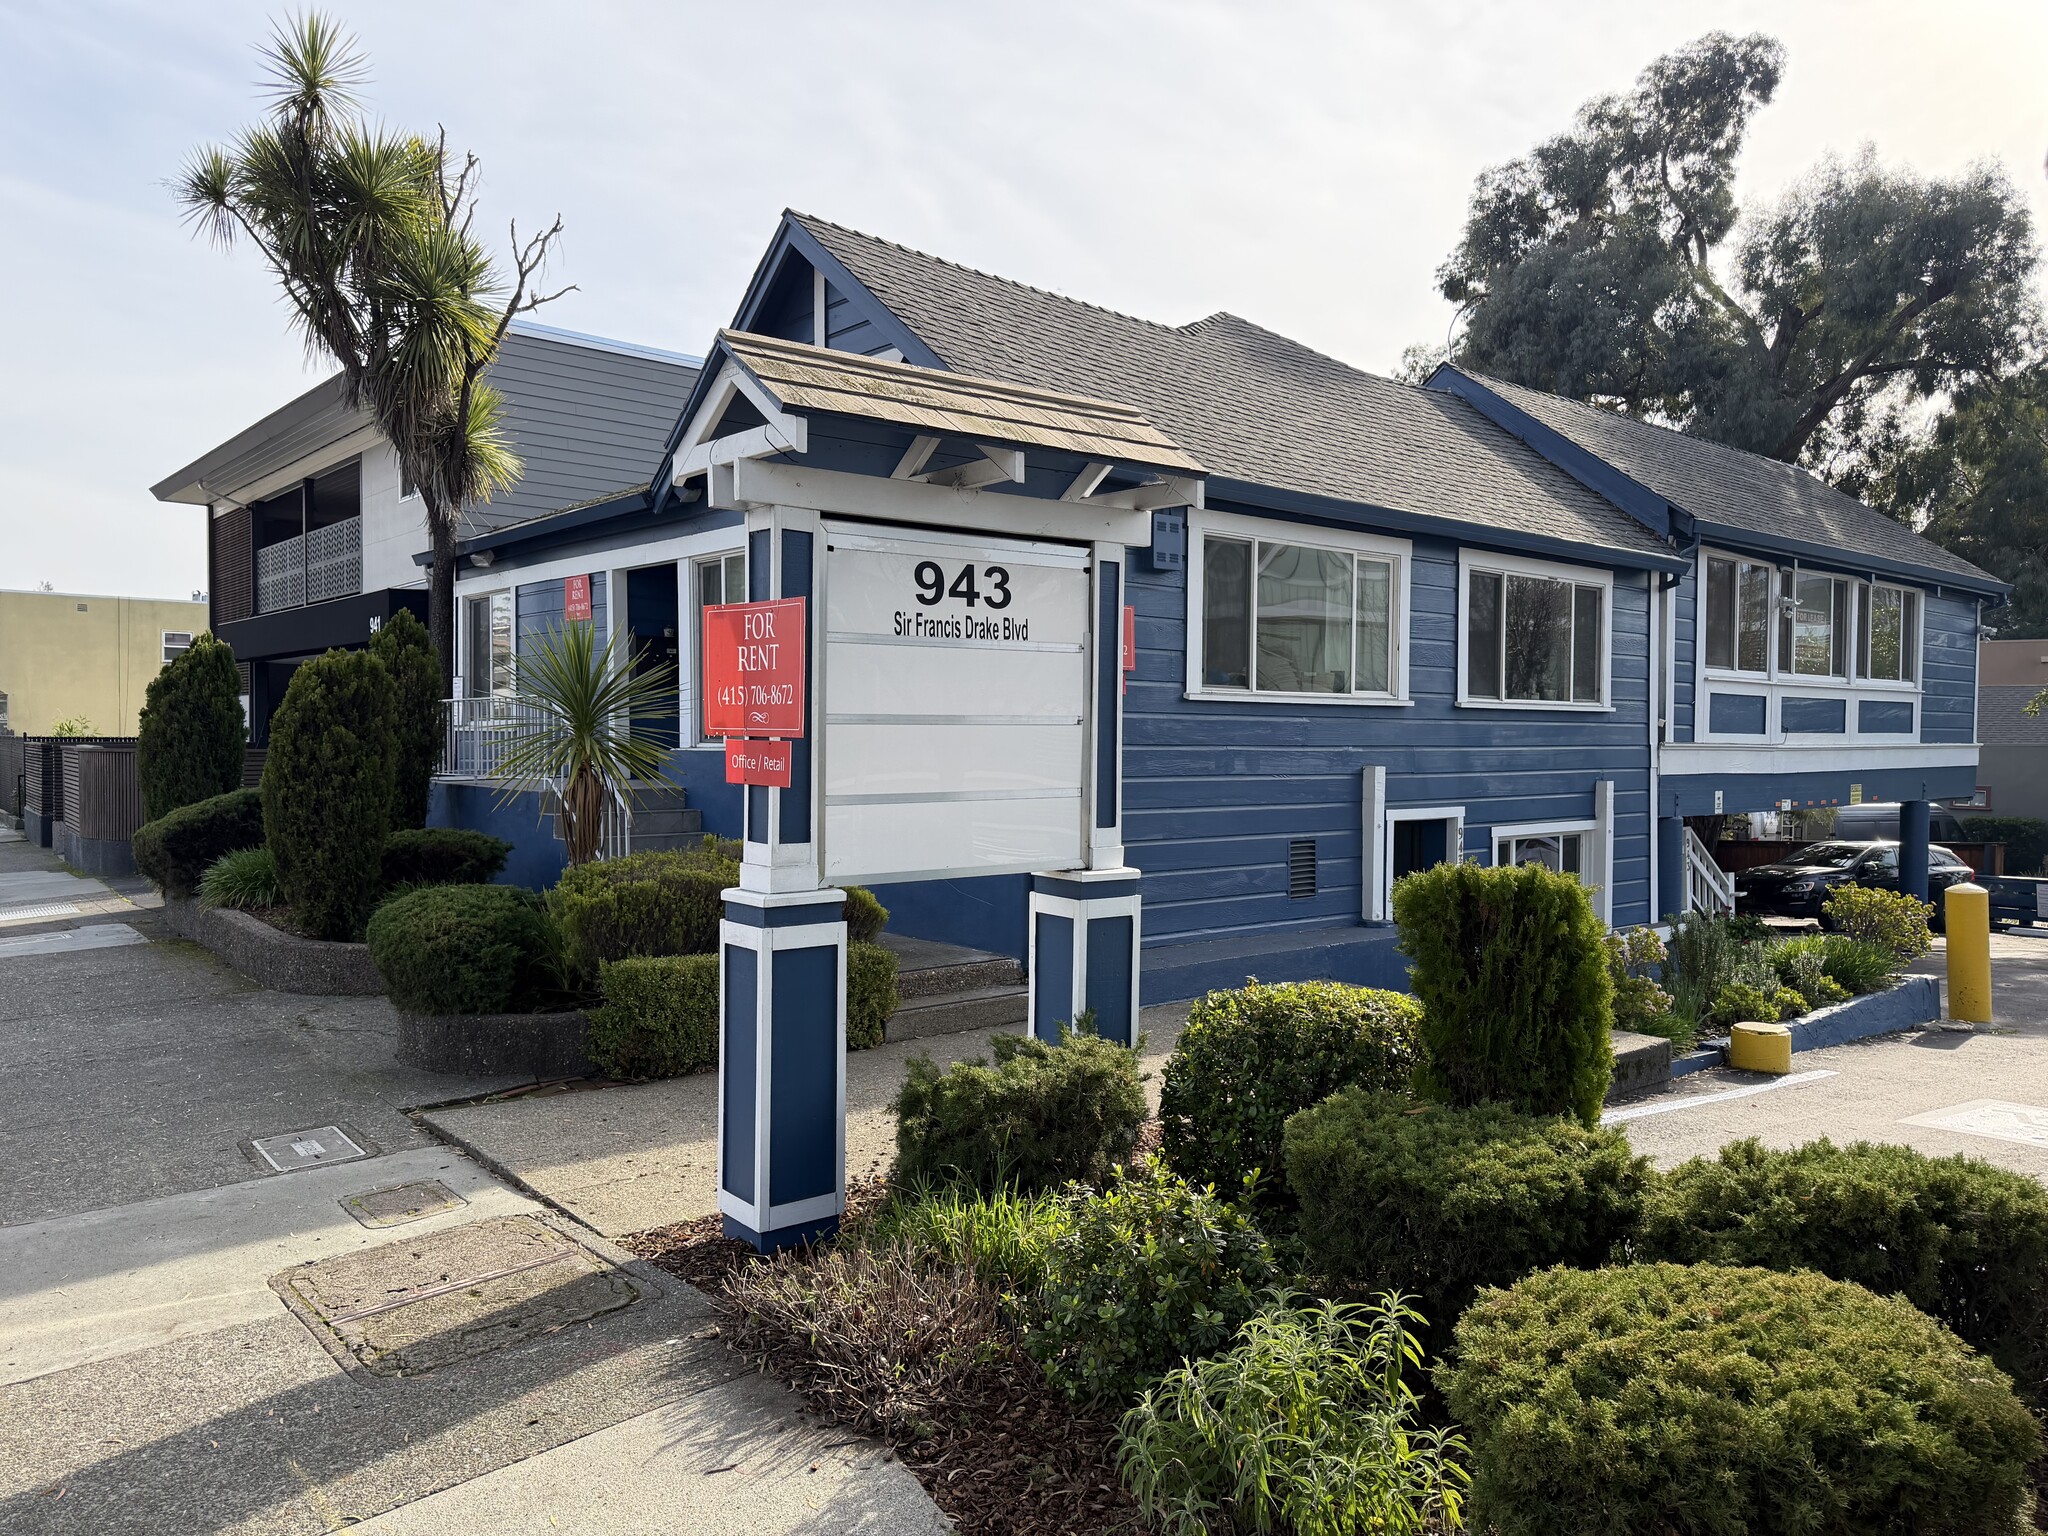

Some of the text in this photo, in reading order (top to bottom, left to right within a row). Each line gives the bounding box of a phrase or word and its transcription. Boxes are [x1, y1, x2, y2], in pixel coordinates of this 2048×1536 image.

[914, 561, 1012, 609] 943
[369, 615, 381, 634] 941
[744, 612, 776, 640] FOR
[894, 611, 1029, 641] Sir Francis Drake Blvd
[1797, 612, 1825, 622] FOR LEASE
[737, 644, 780, 672] RENT
[717, 684, 793, 707] (415) 706-8672
[731, 754, 785, 772] Office / Retail
